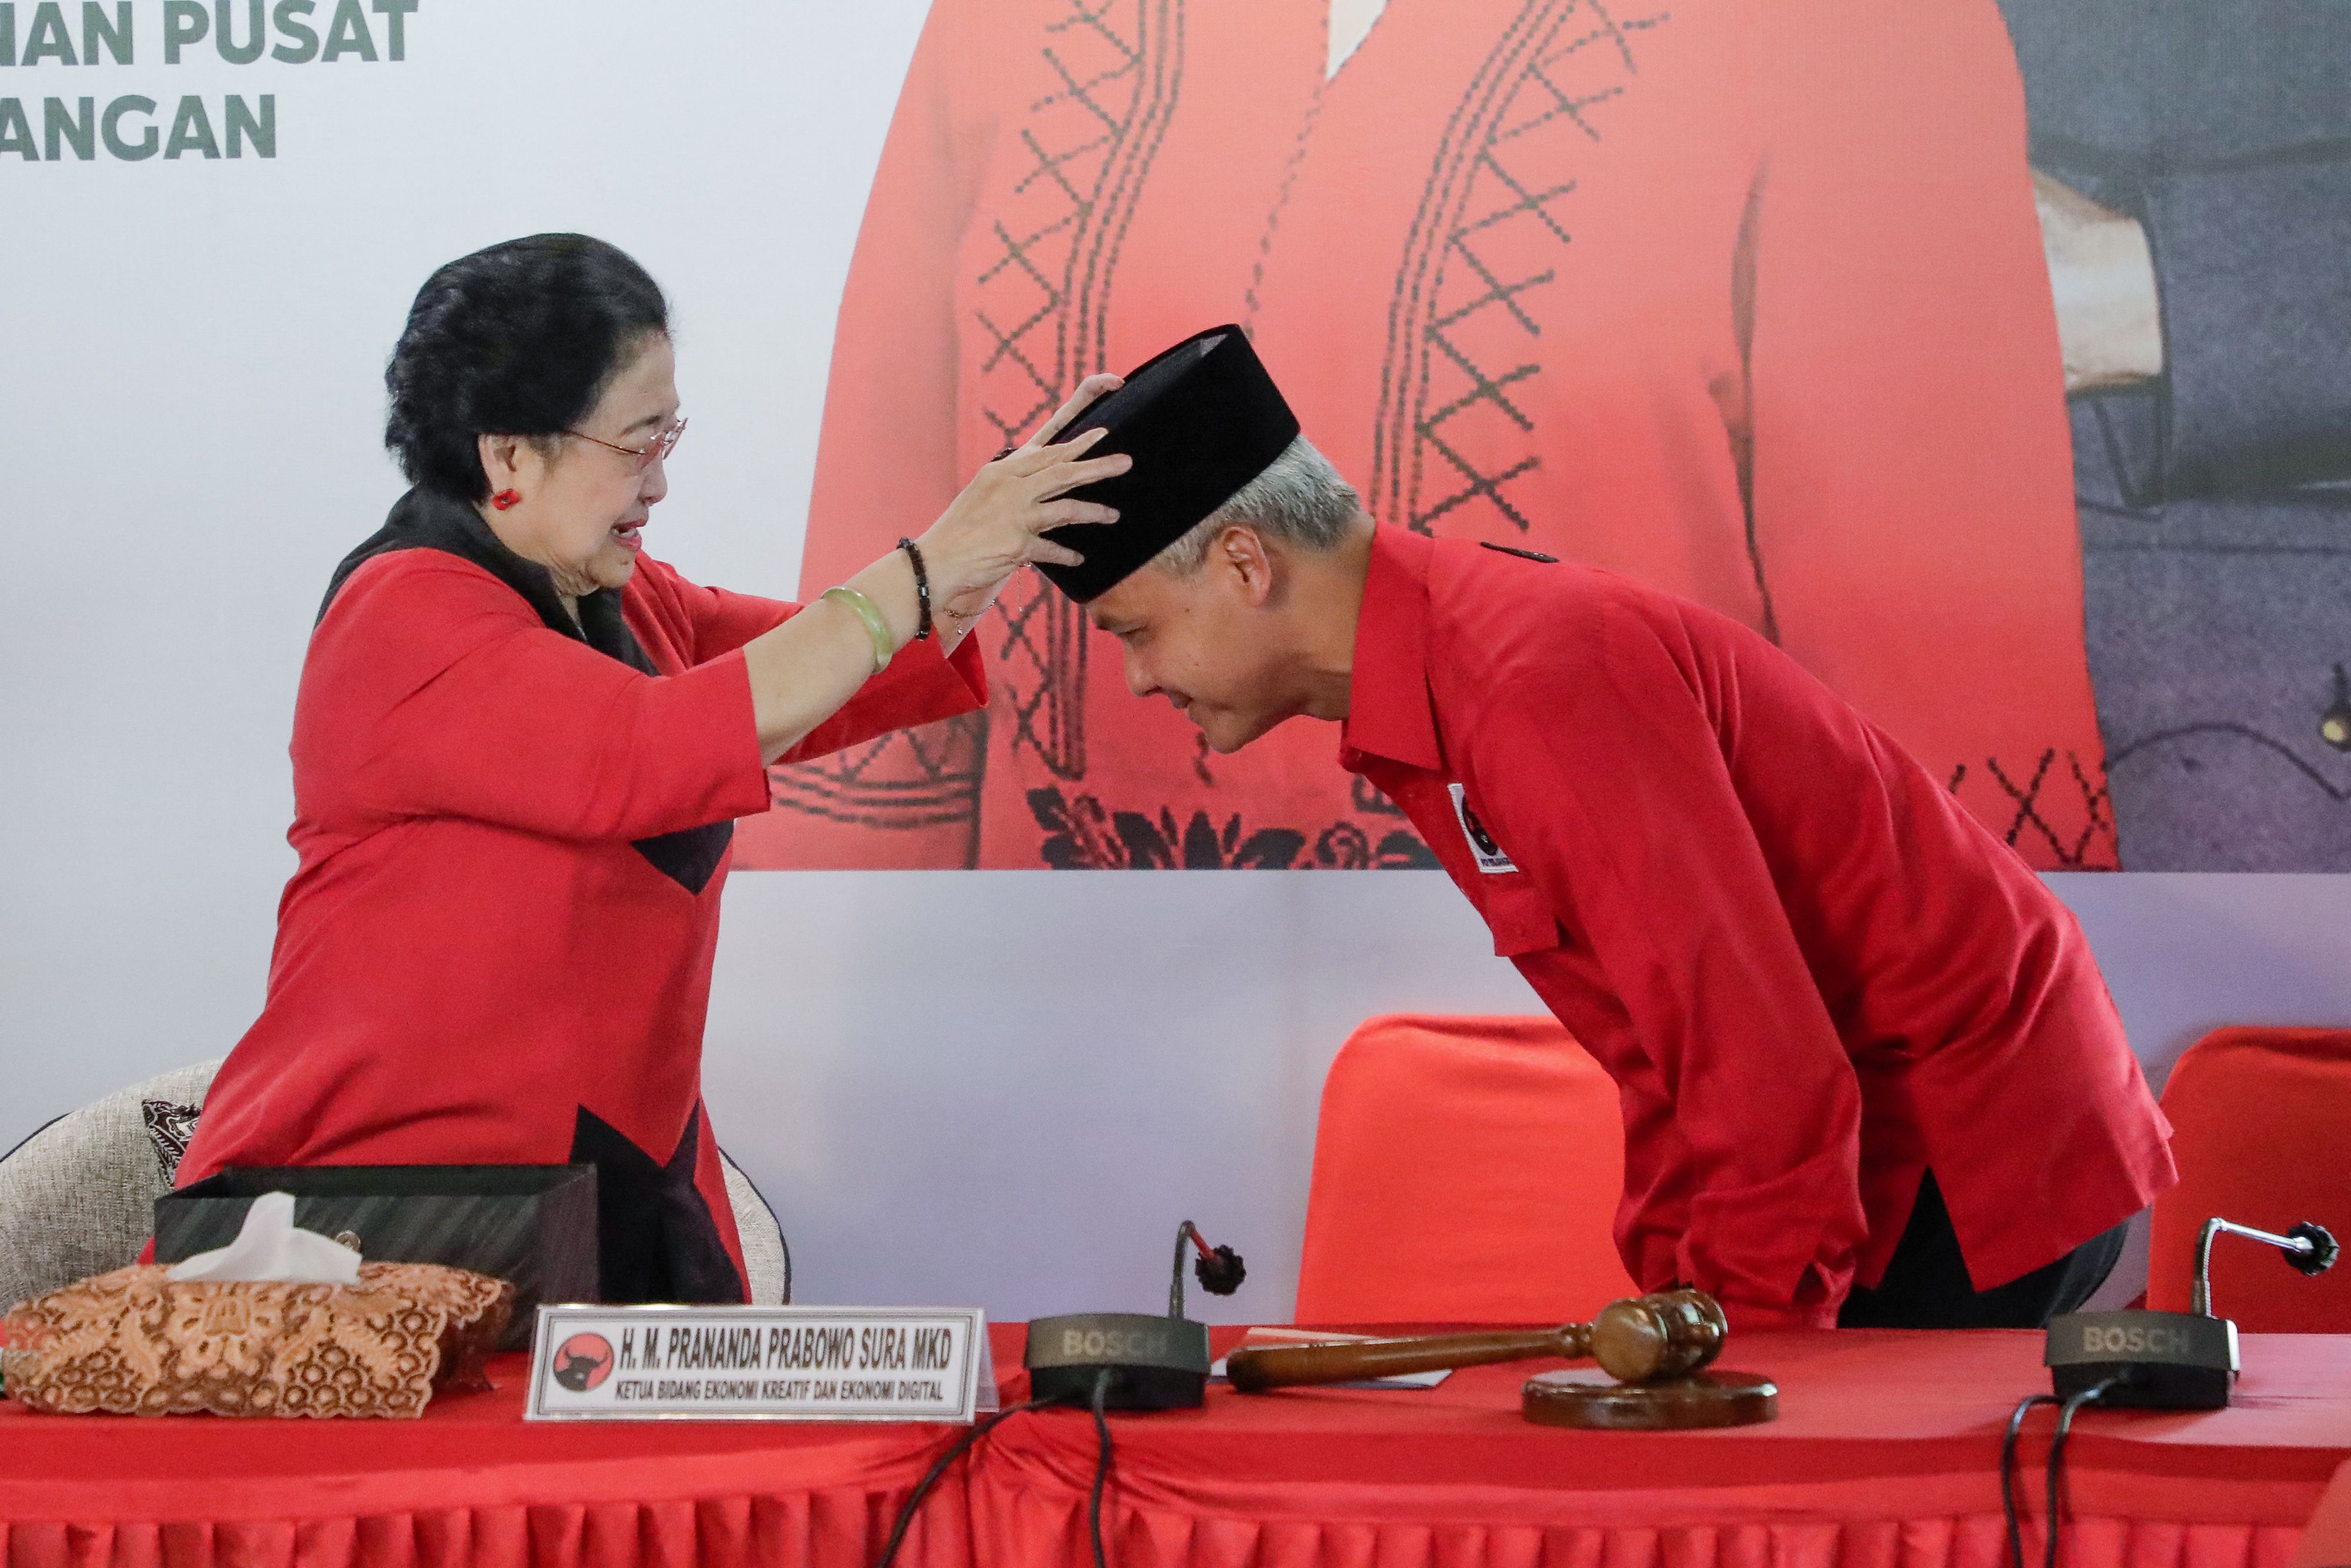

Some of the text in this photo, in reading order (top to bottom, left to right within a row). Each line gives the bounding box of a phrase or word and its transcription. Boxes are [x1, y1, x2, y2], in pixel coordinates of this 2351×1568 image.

[163, 0, 418, 65] PUSAT
[0, 95, 276, 162] ANGAN
[619, 1327, 952, 1371] H. M. PRANANDA PRABOWO SURA MKD
[1063, 1329, 1168, 1356] BOSCH
[2083, 1326, 2191, 1354] BOSCH
[615, 1380, 944, 1401] KETUA BIDANG EKONOMI KREATIF DAN EKONOMI DIGITAL
